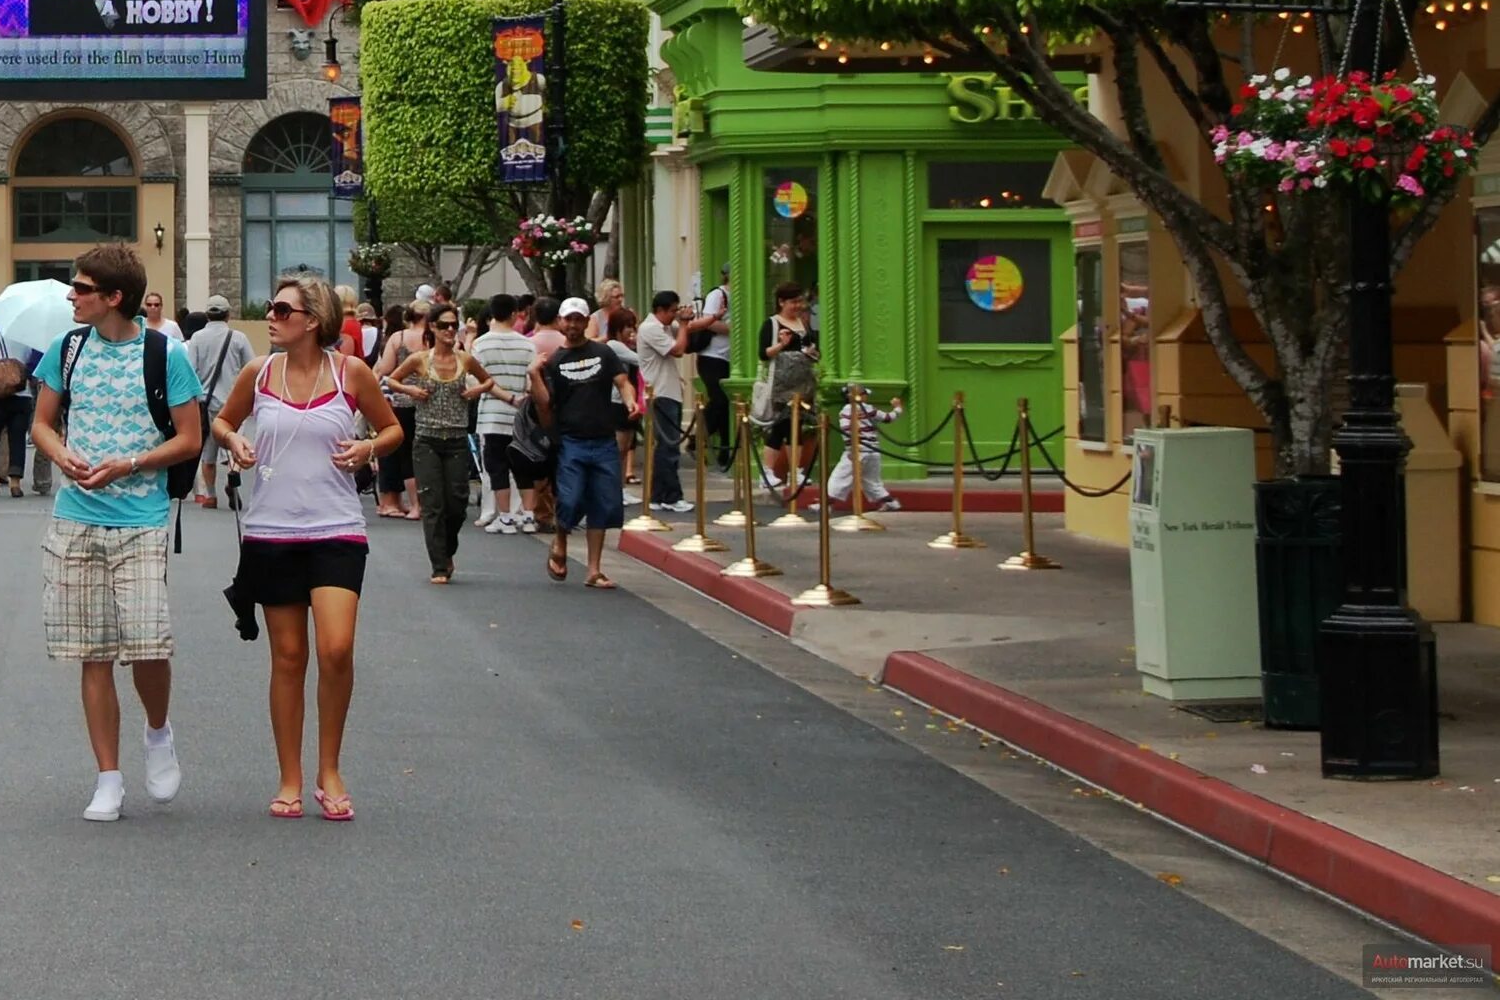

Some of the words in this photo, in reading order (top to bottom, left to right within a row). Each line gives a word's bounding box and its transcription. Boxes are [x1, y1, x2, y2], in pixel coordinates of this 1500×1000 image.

[100, 0, 114, 16] A
[27, 51, 57, 65] used
[63, 51, 82, 65] for
[87, 52, 109, 65] the
[114, 51, 142, 65] film
[146, 51, 199, 65] because
[204, 51, 245, 65] Hum
